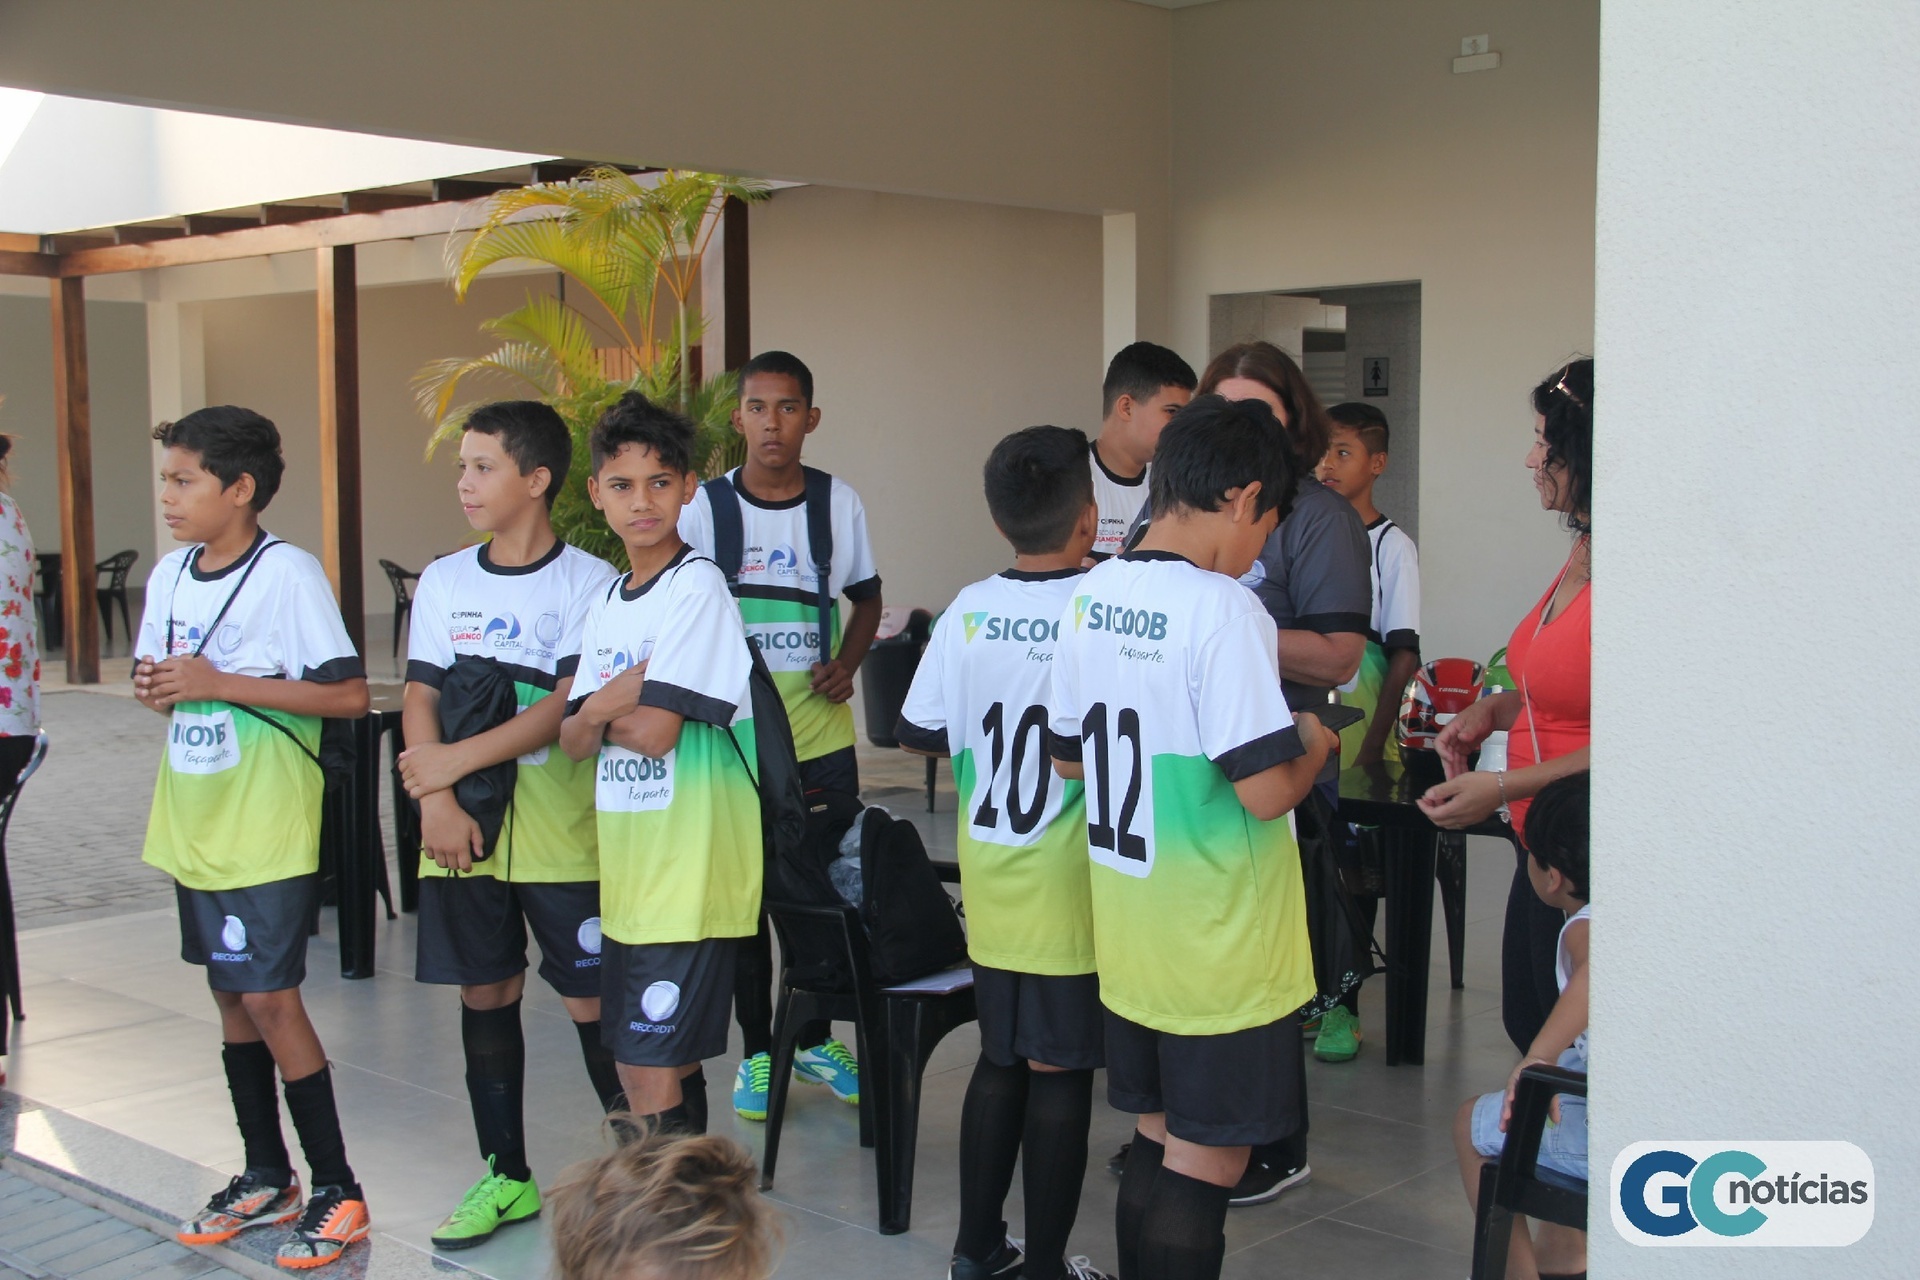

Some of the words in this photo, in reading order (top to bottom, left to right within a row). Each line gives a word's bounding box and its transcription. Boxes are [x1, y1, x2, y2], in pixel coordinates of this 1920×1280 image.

[1088, 602, 1168, 641] SICOOB
[494, 640, 524, 648] CAPITAL
[601, 757, 667, 783] SICOOB
[973, 701, 1049, 835] 10
[1082, 701, 1147, 863] 12
